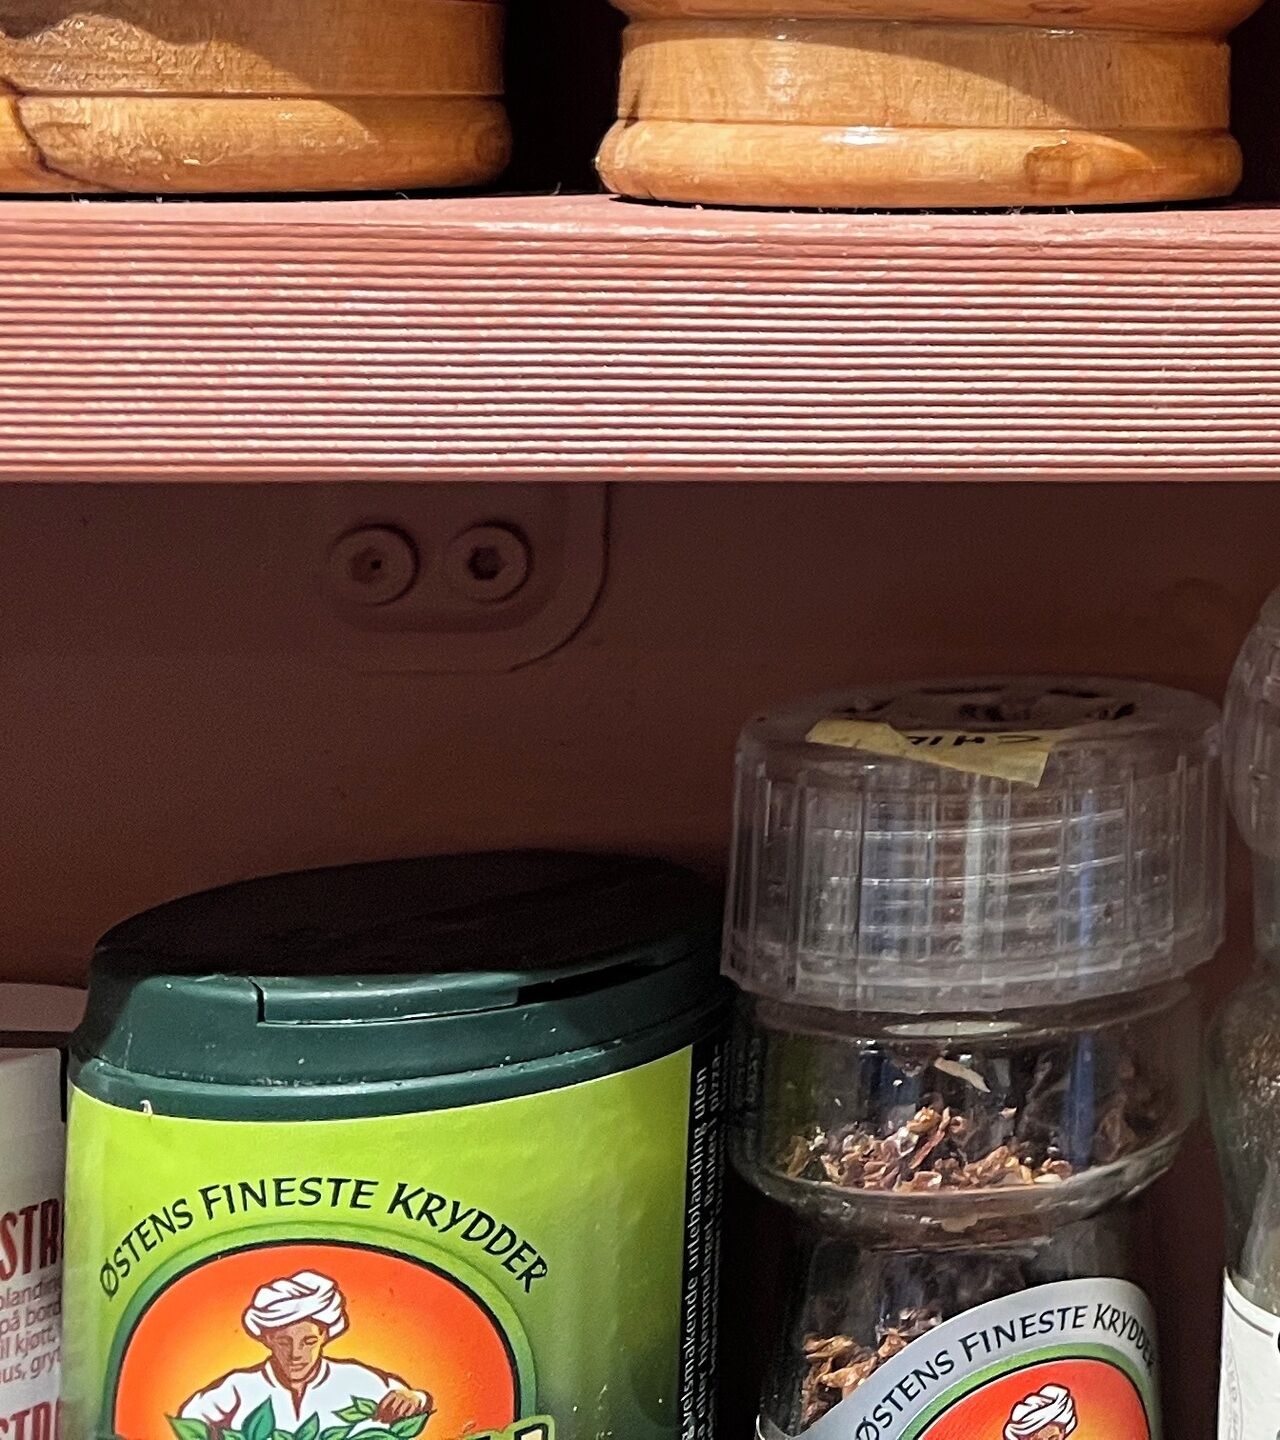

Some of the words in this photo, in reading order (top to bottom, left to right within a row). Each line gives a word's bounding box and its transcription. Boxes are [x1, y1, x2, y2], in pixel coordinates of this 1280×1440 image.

[99, 1198, 194, 1302] ØSTENS
[198, 1176, 380, 1221] FINESTE
[386, 1181, 549, 1295] KRYDDER
[957, 1304, 1089, 1362] FINESTE
